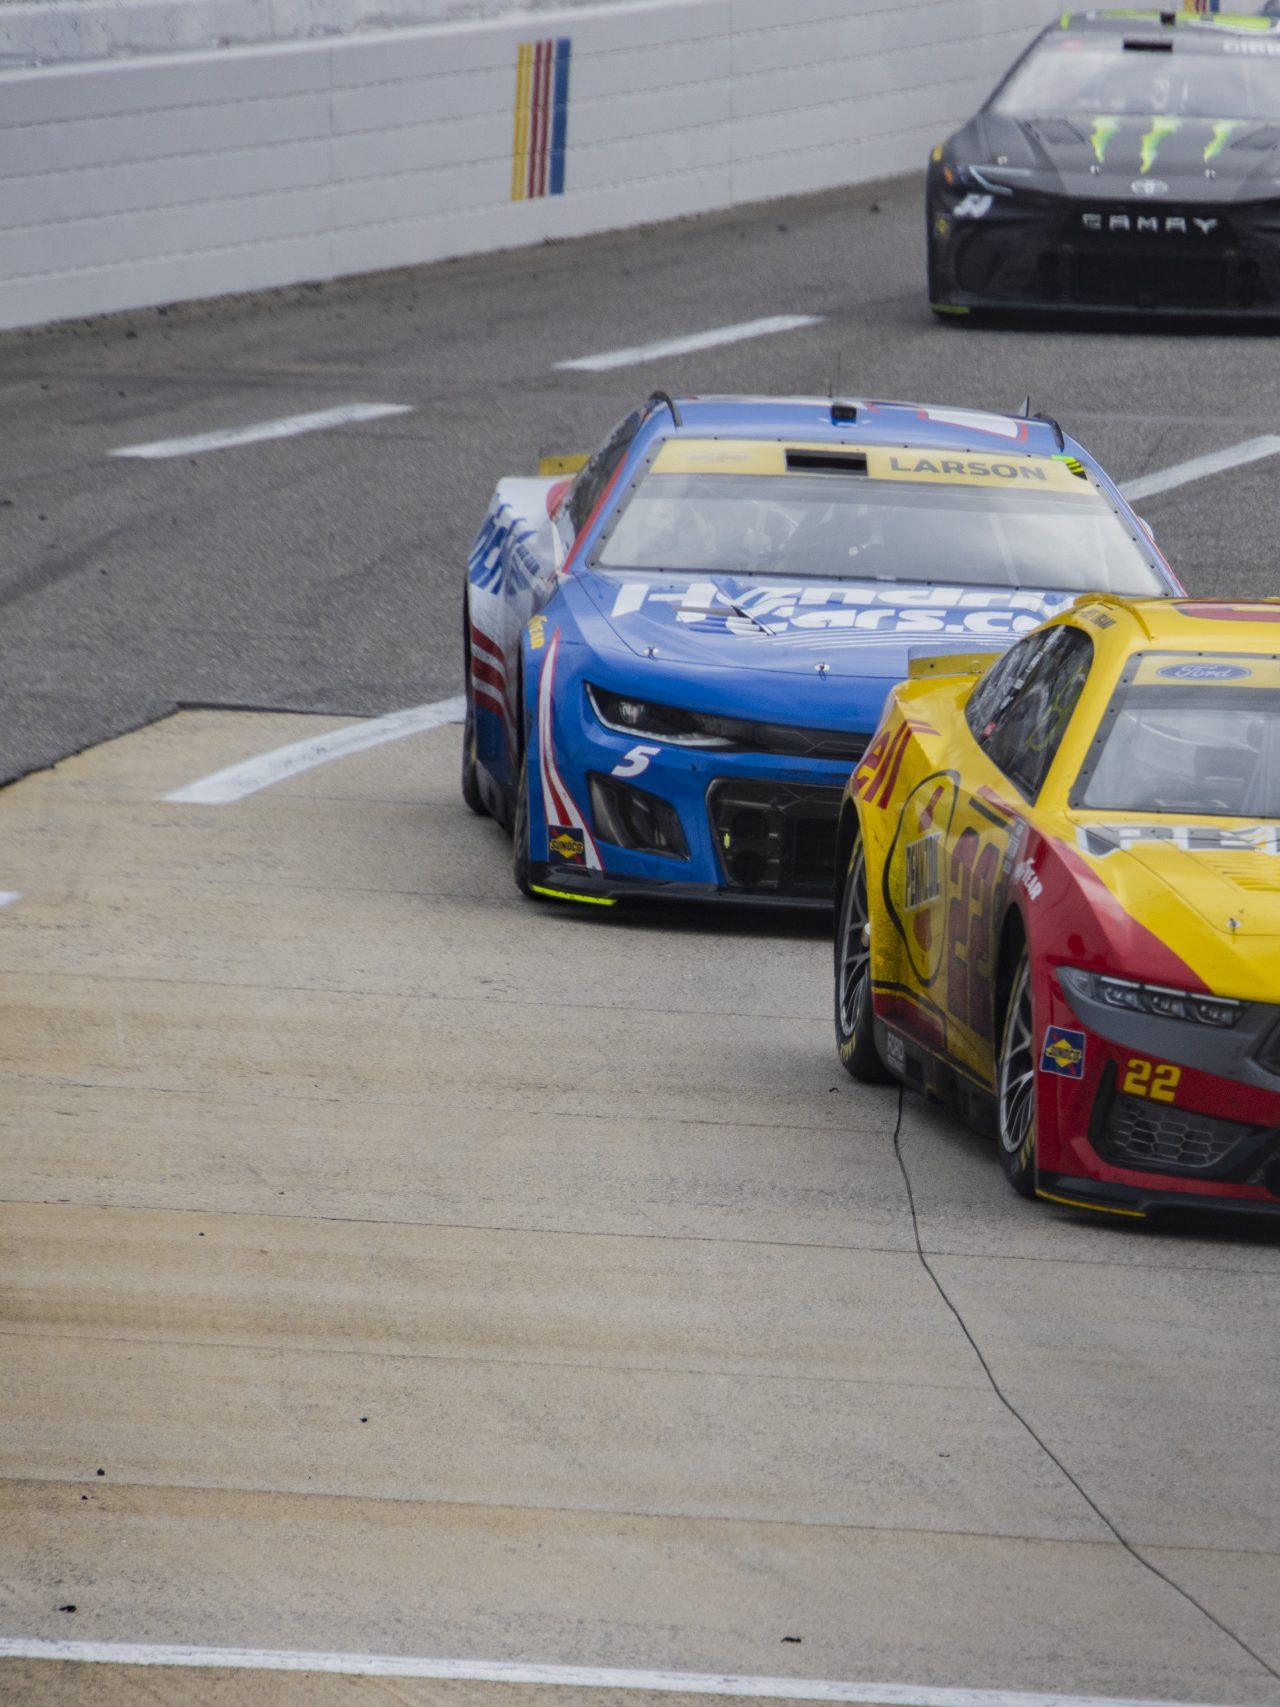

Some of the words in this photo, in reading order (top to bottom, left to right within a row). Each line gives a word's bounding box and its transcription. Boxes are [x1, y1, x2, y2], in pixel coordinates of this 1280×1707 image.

[1082, 213, 1219, 234] CAMRY
[889, 456, 1048, 481] LARSON
[1172, 664, 1236, 680] Ford
[611, 744, 661, 778] 5
[1122, 1058, 1182, 1102] 22
